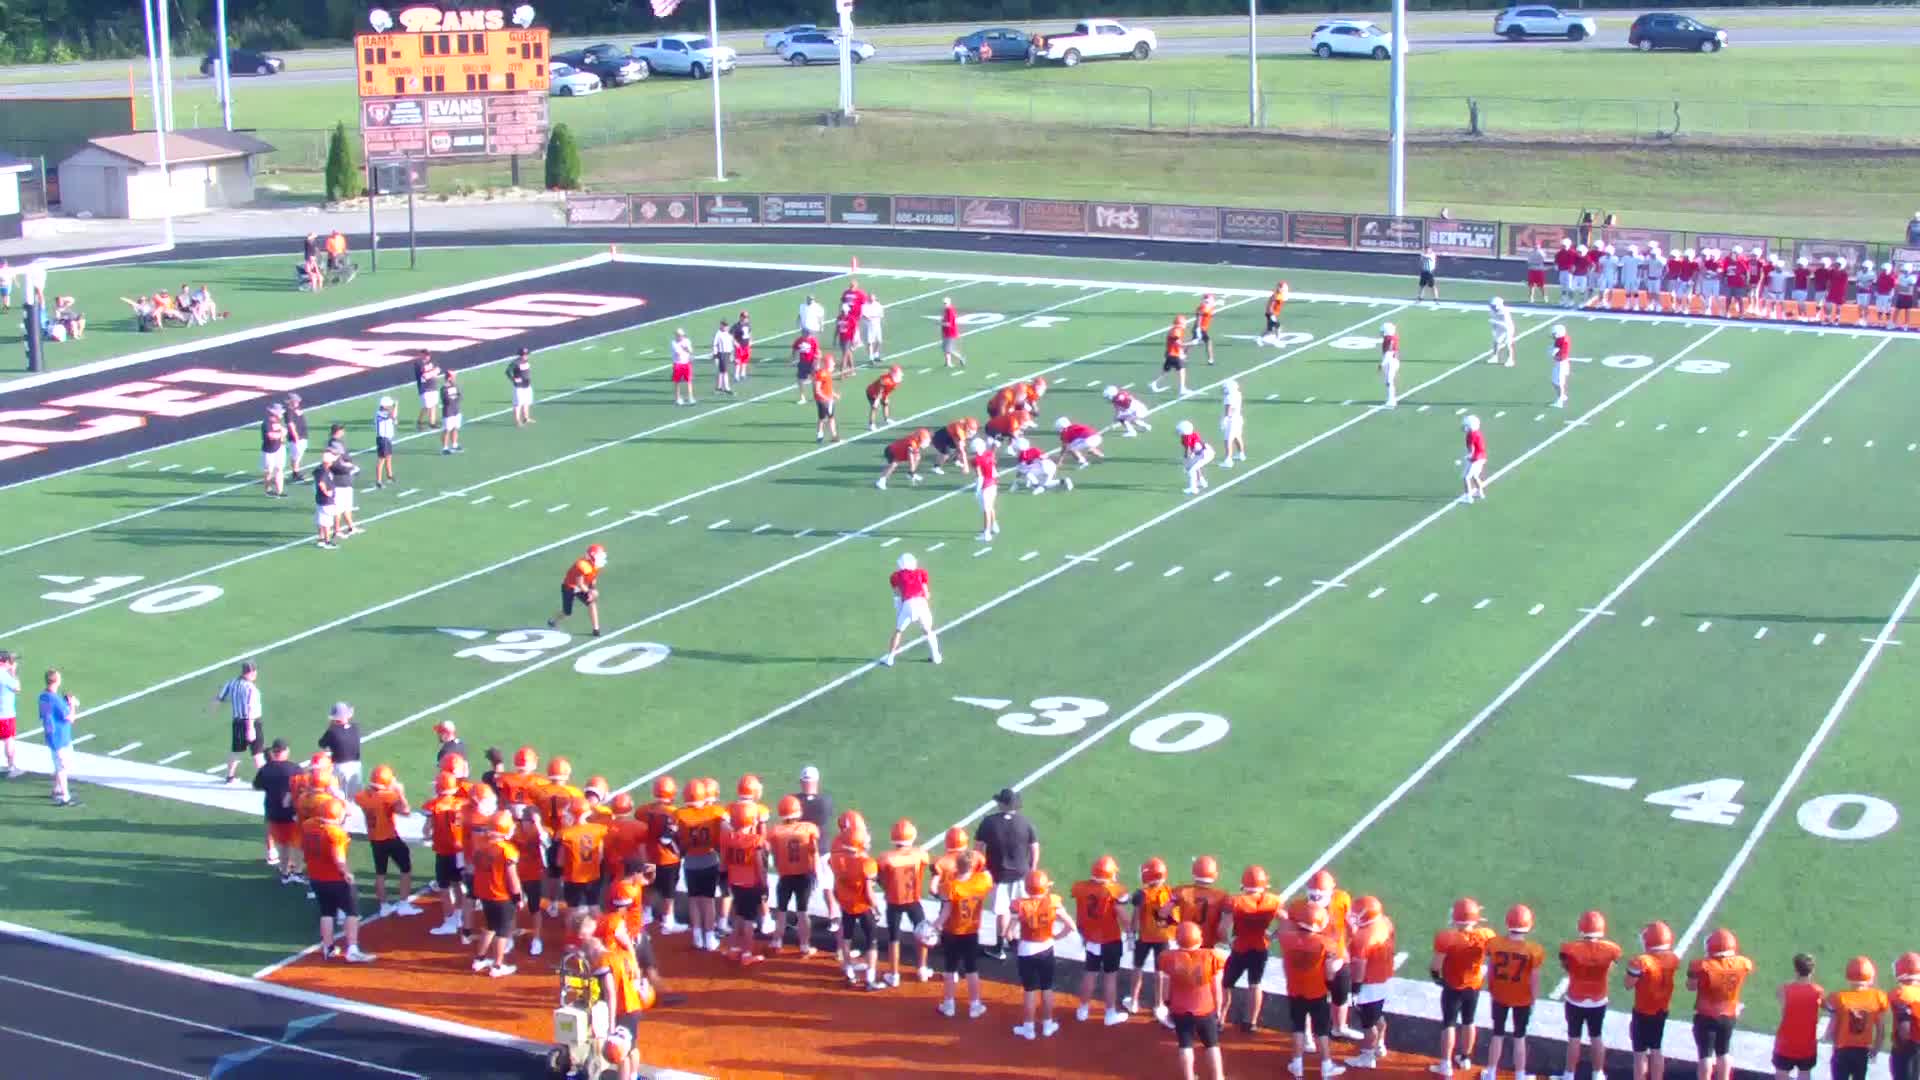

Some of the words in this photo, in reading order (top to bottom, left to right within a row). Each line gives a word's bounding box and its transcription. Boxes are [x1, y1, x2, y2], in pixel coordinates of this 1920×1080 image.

[400, 7, 504, 32] RAMS
[509, 31, 543, 41] GUEST
[428, 99, 483, 116] EVANS
[1429, 231, 1493, 248] BENTLEY
[1495, 951, 1528, 982] 27
